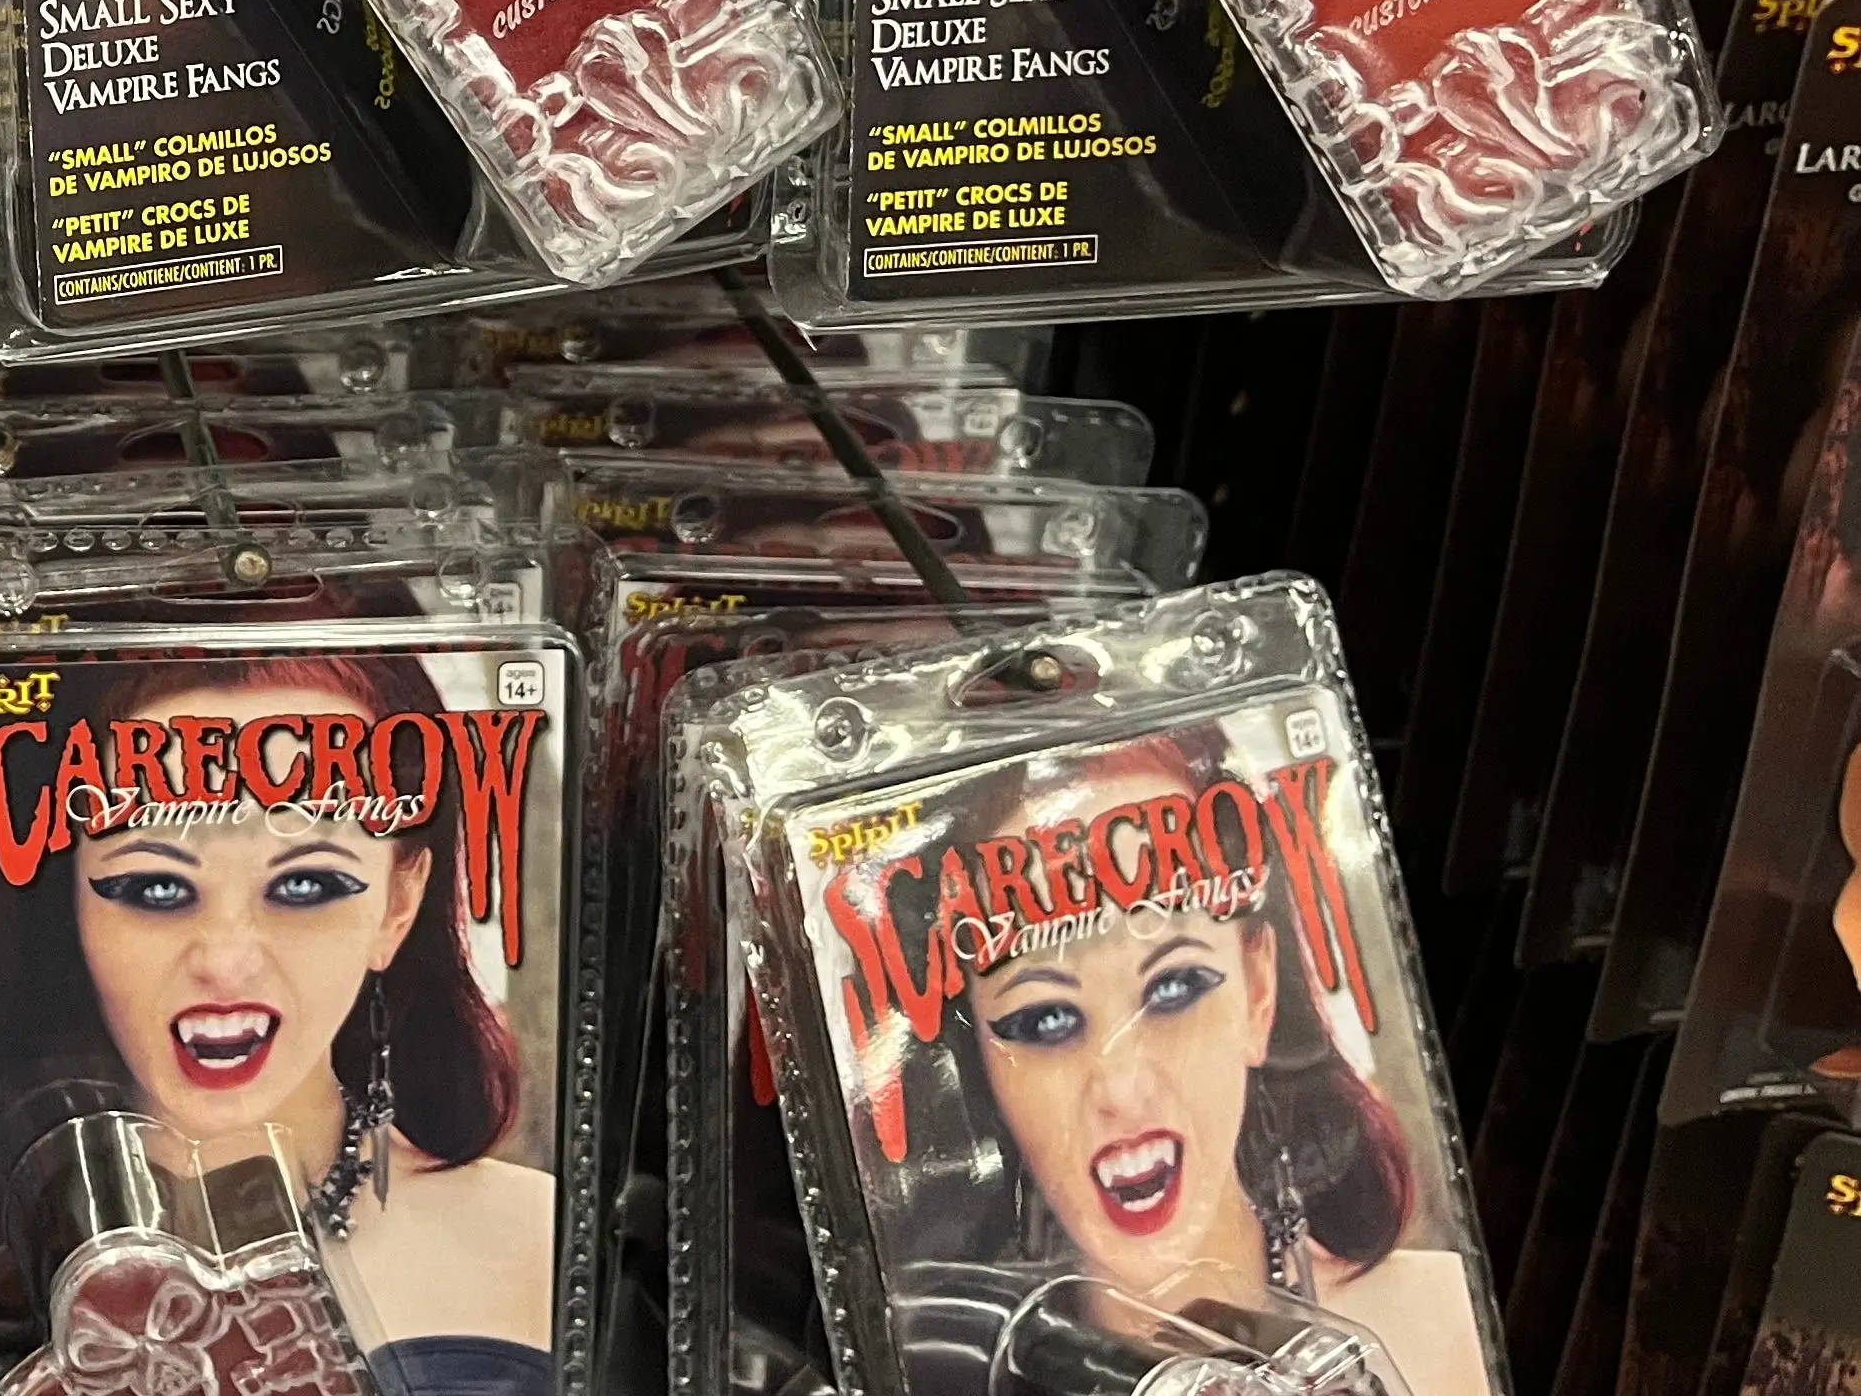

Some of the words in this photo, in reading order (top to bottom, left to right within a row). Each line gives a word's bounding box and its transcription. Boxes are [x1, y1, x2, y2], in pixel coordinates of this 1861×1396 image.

[871, 17, 986, 53] DELUXE
[41, 35, 160, 78] DELUXE
[871, 56, 1003, 90] VAMPIRE
[1011, 47, 1110, 82] FANGS
[43, 69, 179, 115] VAMPIRE
[186, 58, 282, 98] FANGS
[153, 124, 278, 158] COLMILLOS
[974, 114, 1101, 138] COLMILLOS
[49, 175, 79, 197] DE
[84, 161, 191, 193] VAMPIRO
[198, 156, 226, 179] DE
[232, 143, 332, 173] LUJOSOS
[868, 151, 895, 170] DE
[903, 145, 1009, 168] VAMPIRO
[1017, 141, 1045, 161] DE
[1053, 136, 1156, 159] LUJOSOS
[141, 198, 217, 226] CROCS
[222, 194, 251, 218] DE
[955, 183, 1033, 206] CROCS
[1040, 181, 1068, 201] DE
[866, 212, 965, 237] VAMPIRE
[973, 209, 1001, 230] DE
[1008, 207, 1065, 227] LUXE
[52, 234, 154, 265] VAMPIRE
[160, 228, 188, 251] DE
[195, 220, 250, 244] LUXE
[868, 245, 1058, 271] CONTAINS/CONTIENE/CONTIENT:
[1062, 243, 1068, 259] 1
[58, 257, 245, 298] CONTAINS/CONTIENE/CONTIENT:
[249, 255, 255, 273] 1
[504, 681, 538, 700] 14+
[65, 783, 251, 840] Vampire
[265, 780, 425, 837] Fangs
[951, 903, 1116, 964] Vampire
[824, 756, 1377, 1164] SCARECROW
